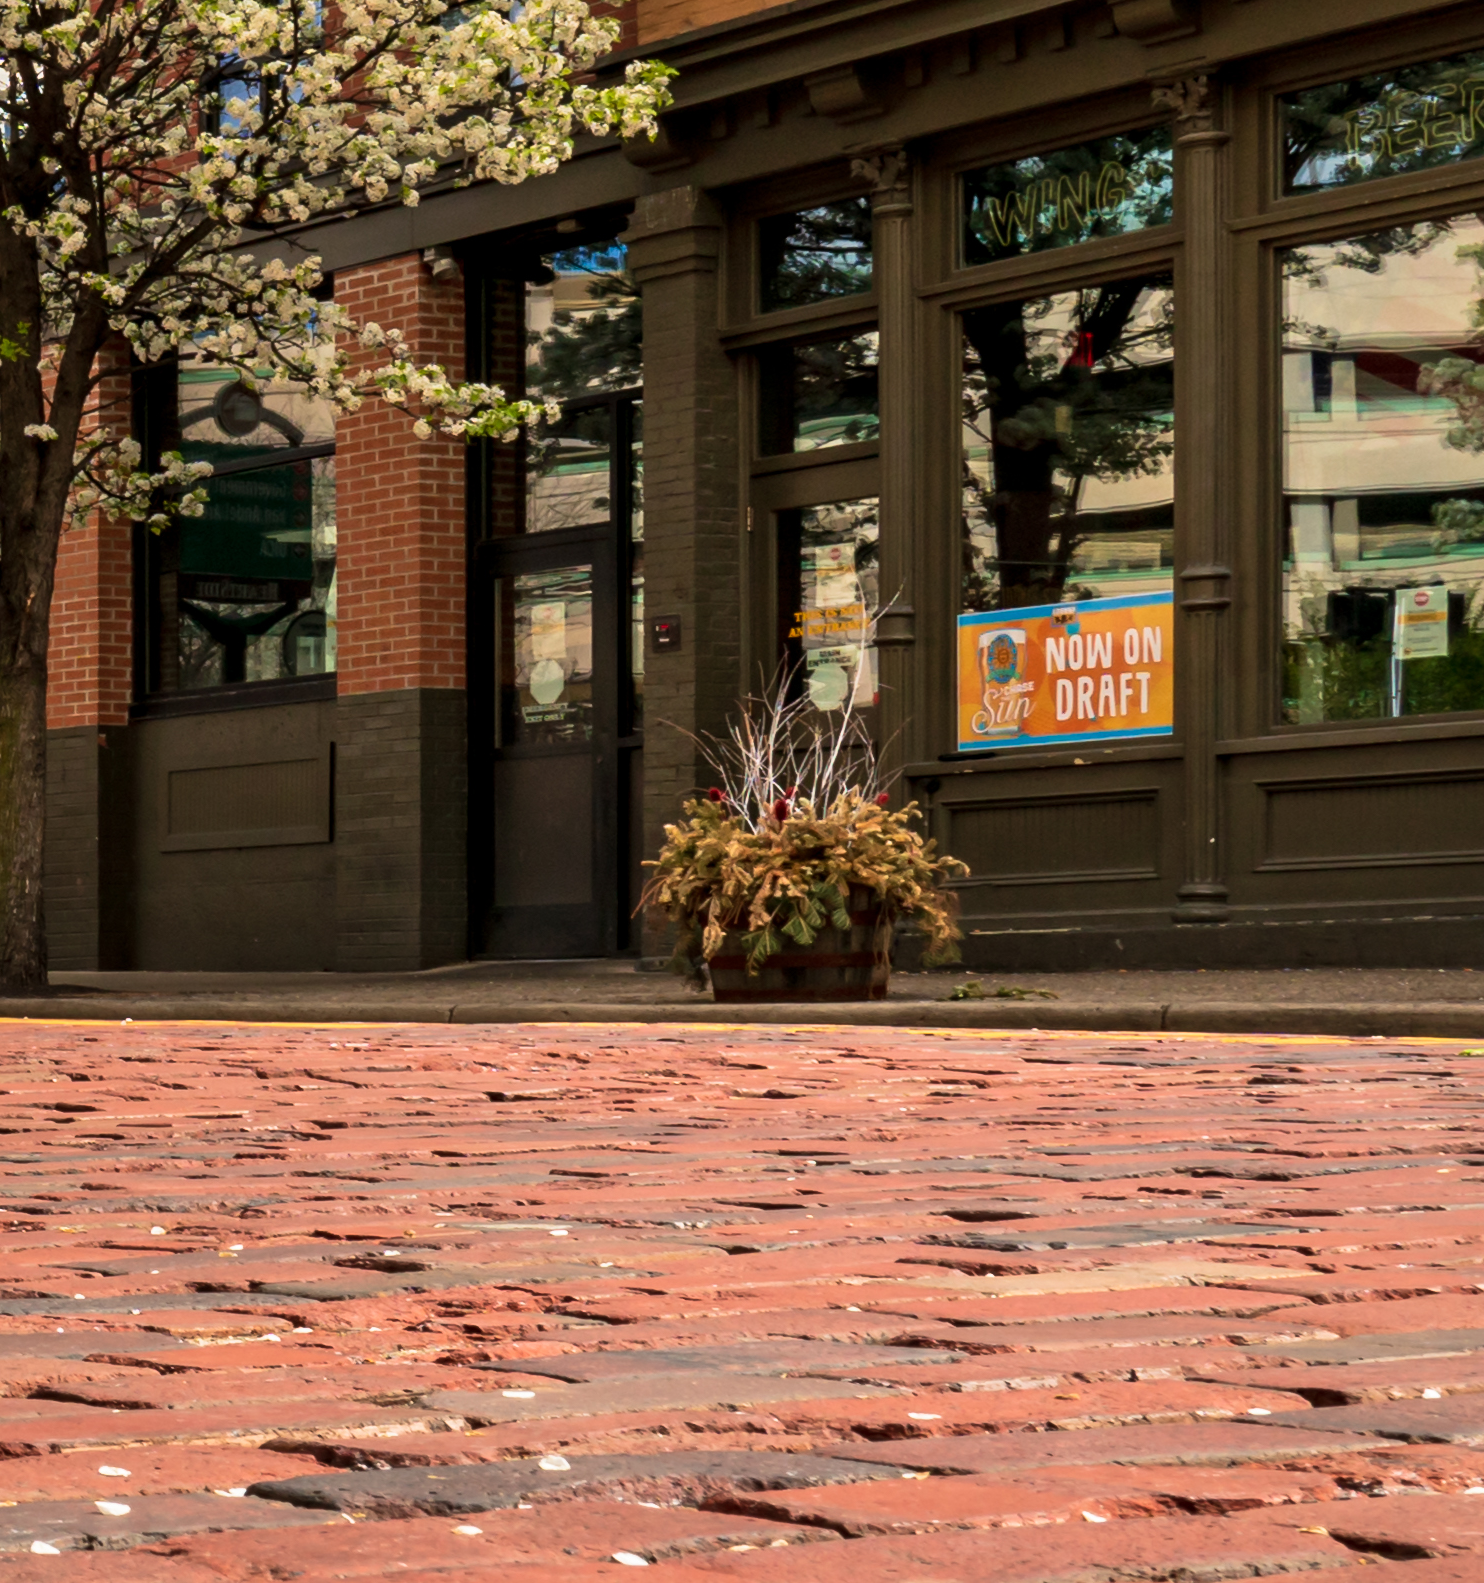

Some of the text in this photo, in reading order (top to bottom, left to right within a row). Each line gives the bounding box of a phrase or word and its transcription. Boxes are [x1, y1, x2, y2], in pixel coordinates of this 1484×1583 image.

[1045, 626, 1162, 673] NOW ON
[1056, 672, 1150, 721] DRAFT
